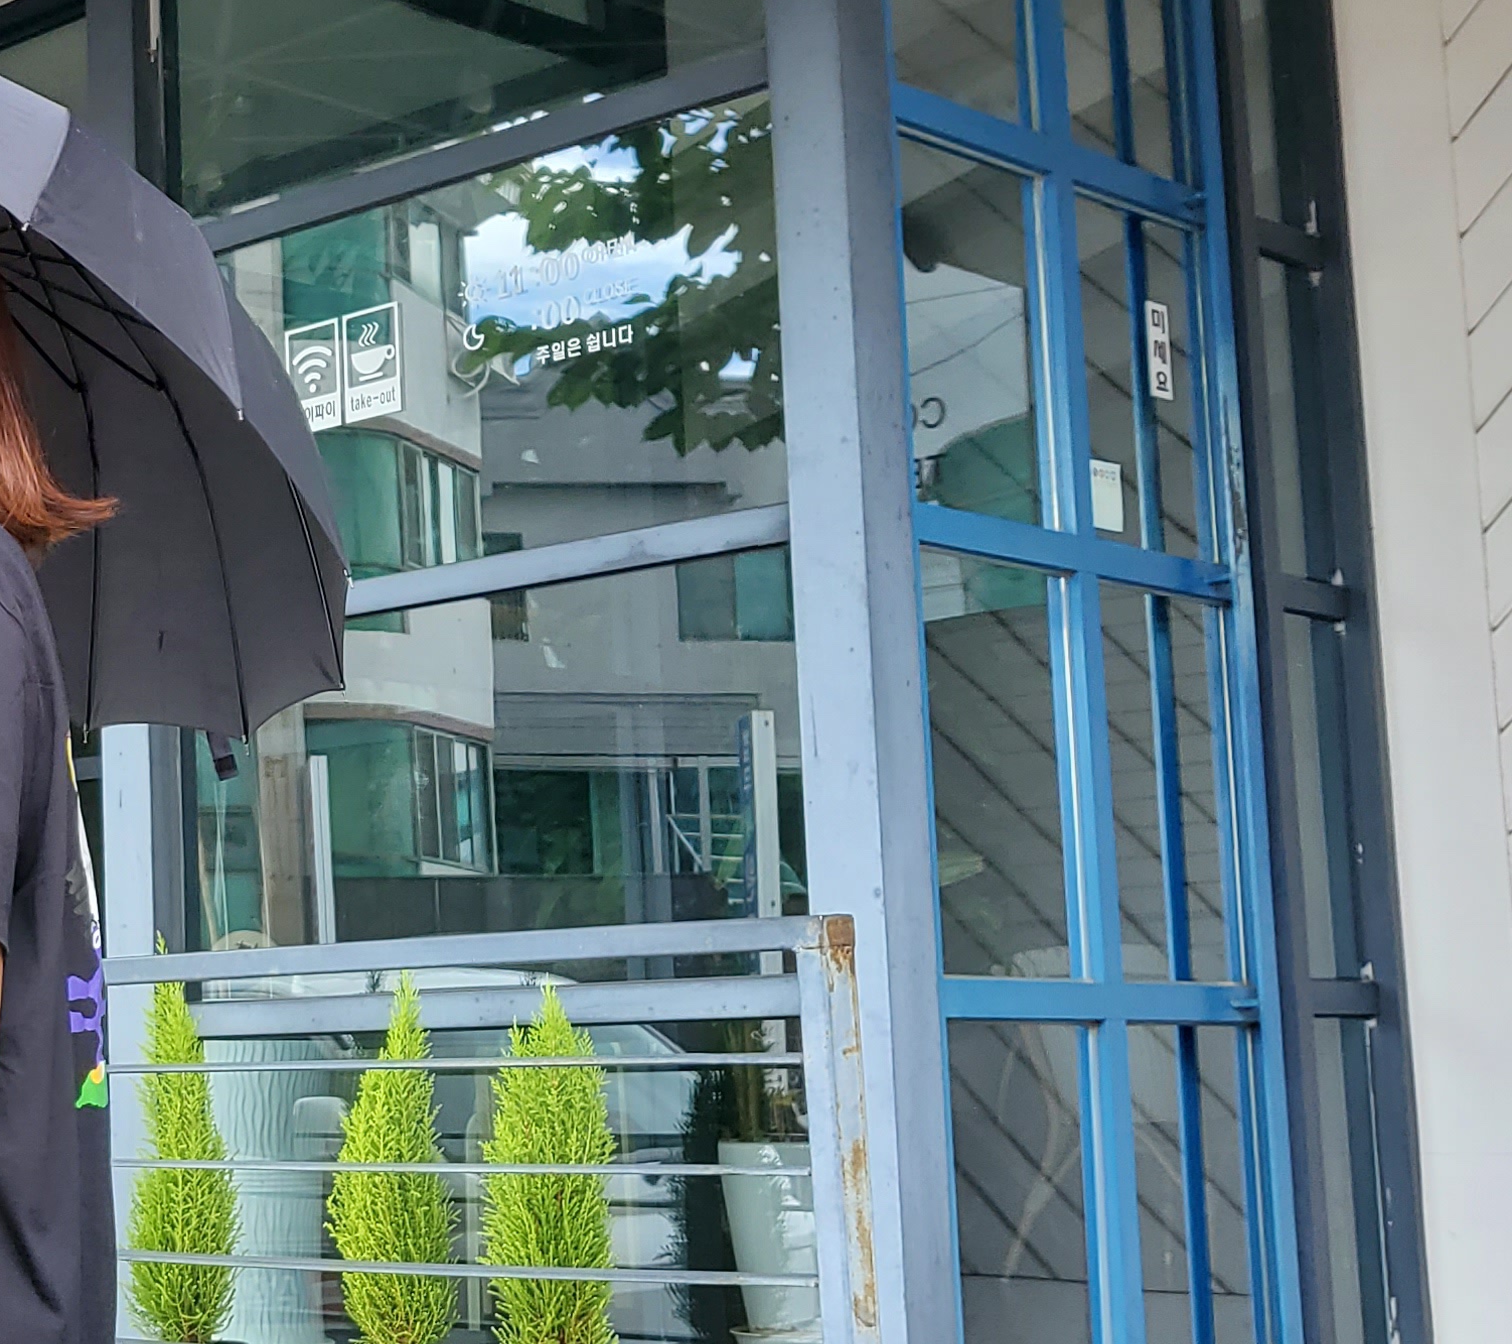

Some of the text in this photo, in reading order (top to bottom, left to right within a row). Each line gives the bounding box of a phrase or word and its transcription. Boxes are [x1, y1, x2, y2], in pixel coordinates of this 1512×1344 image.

[583, 277, 639, 306] CLOSE
[536, 324, 634, 365] 주일은 쉽니다
[305, 400, 336, 422] 이파이
[350, 385, 396, 412] take-out
